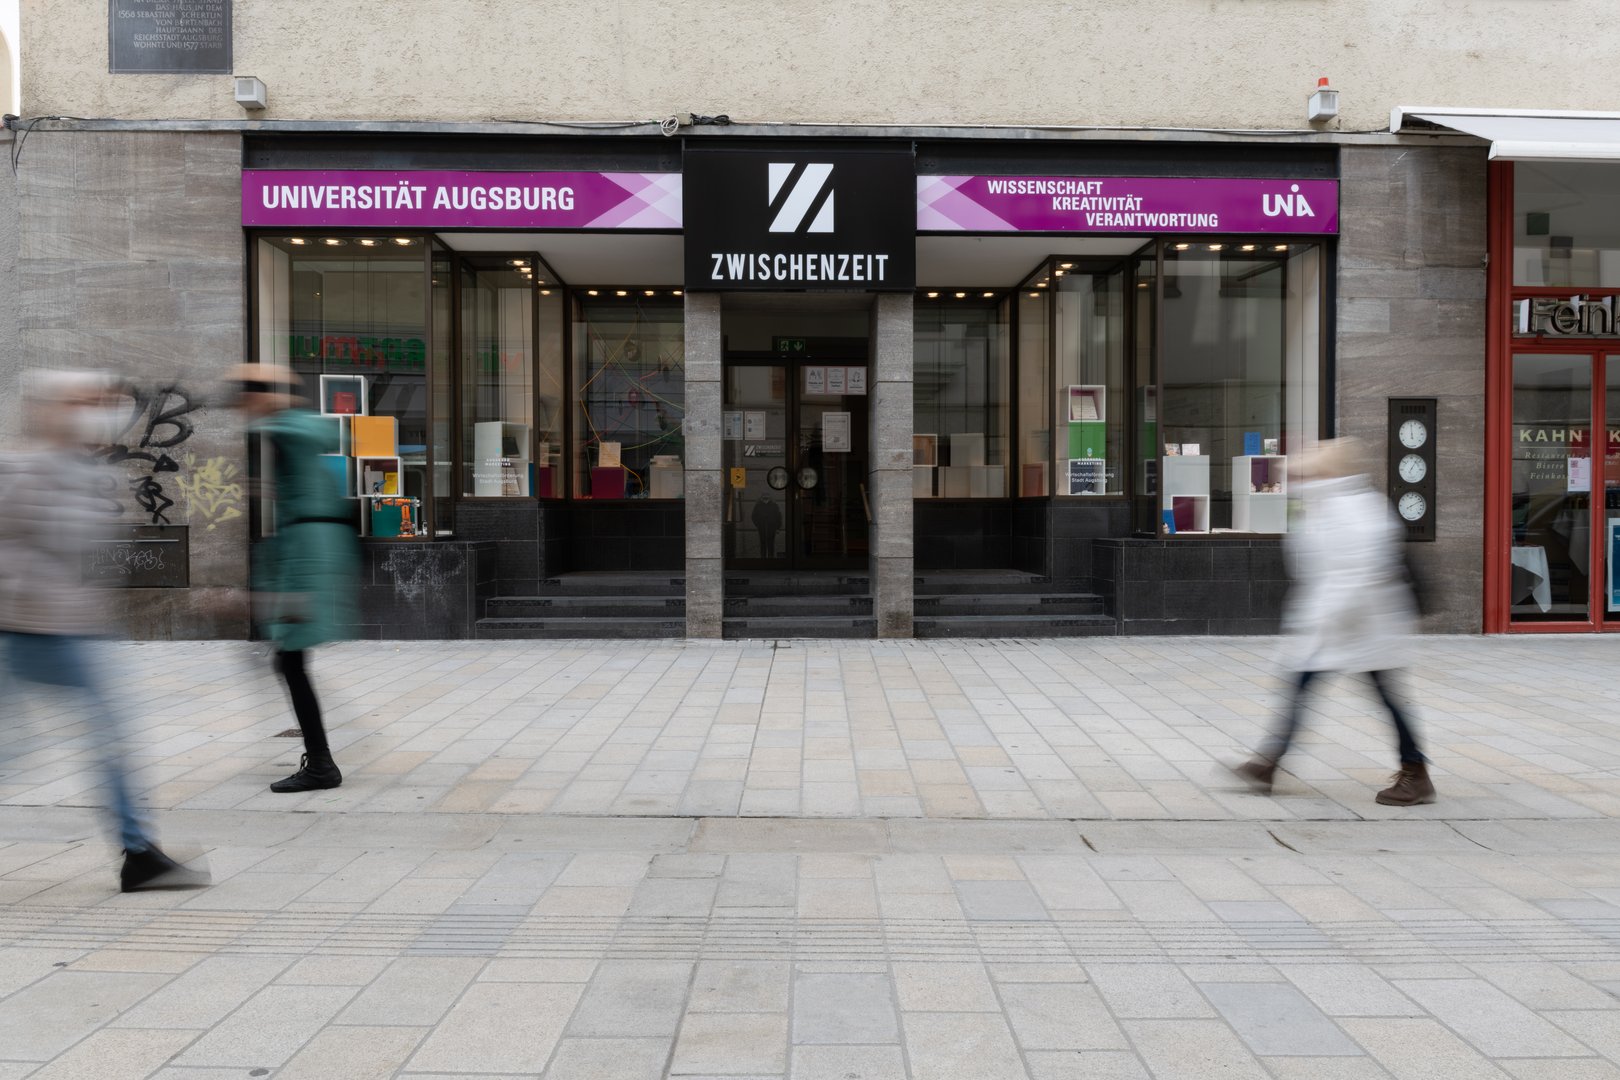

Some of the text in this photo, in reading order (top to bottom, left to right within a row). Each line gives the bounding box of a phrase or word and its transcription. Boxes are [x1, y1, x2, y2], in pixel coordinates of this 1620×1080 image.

[184, 42, 199, 50] 1577
[262, 180, 574, 210] UNIVERSITÄT AUGSBURG
[987, 180, 1103, 195] WISSENSCHAFT
[1052, 194, 1143, 211] KREATIVITÄT
[1086, 212, 1219, 227] VERANTWORTUNG
[711, 253, 889, 281] ZWISCHENZEIT
[1531, 294, 1620, 335] Fein
[1520, 429, 1582, 442] KAHN
[1530, 472, 1568, 480] Feinkos
